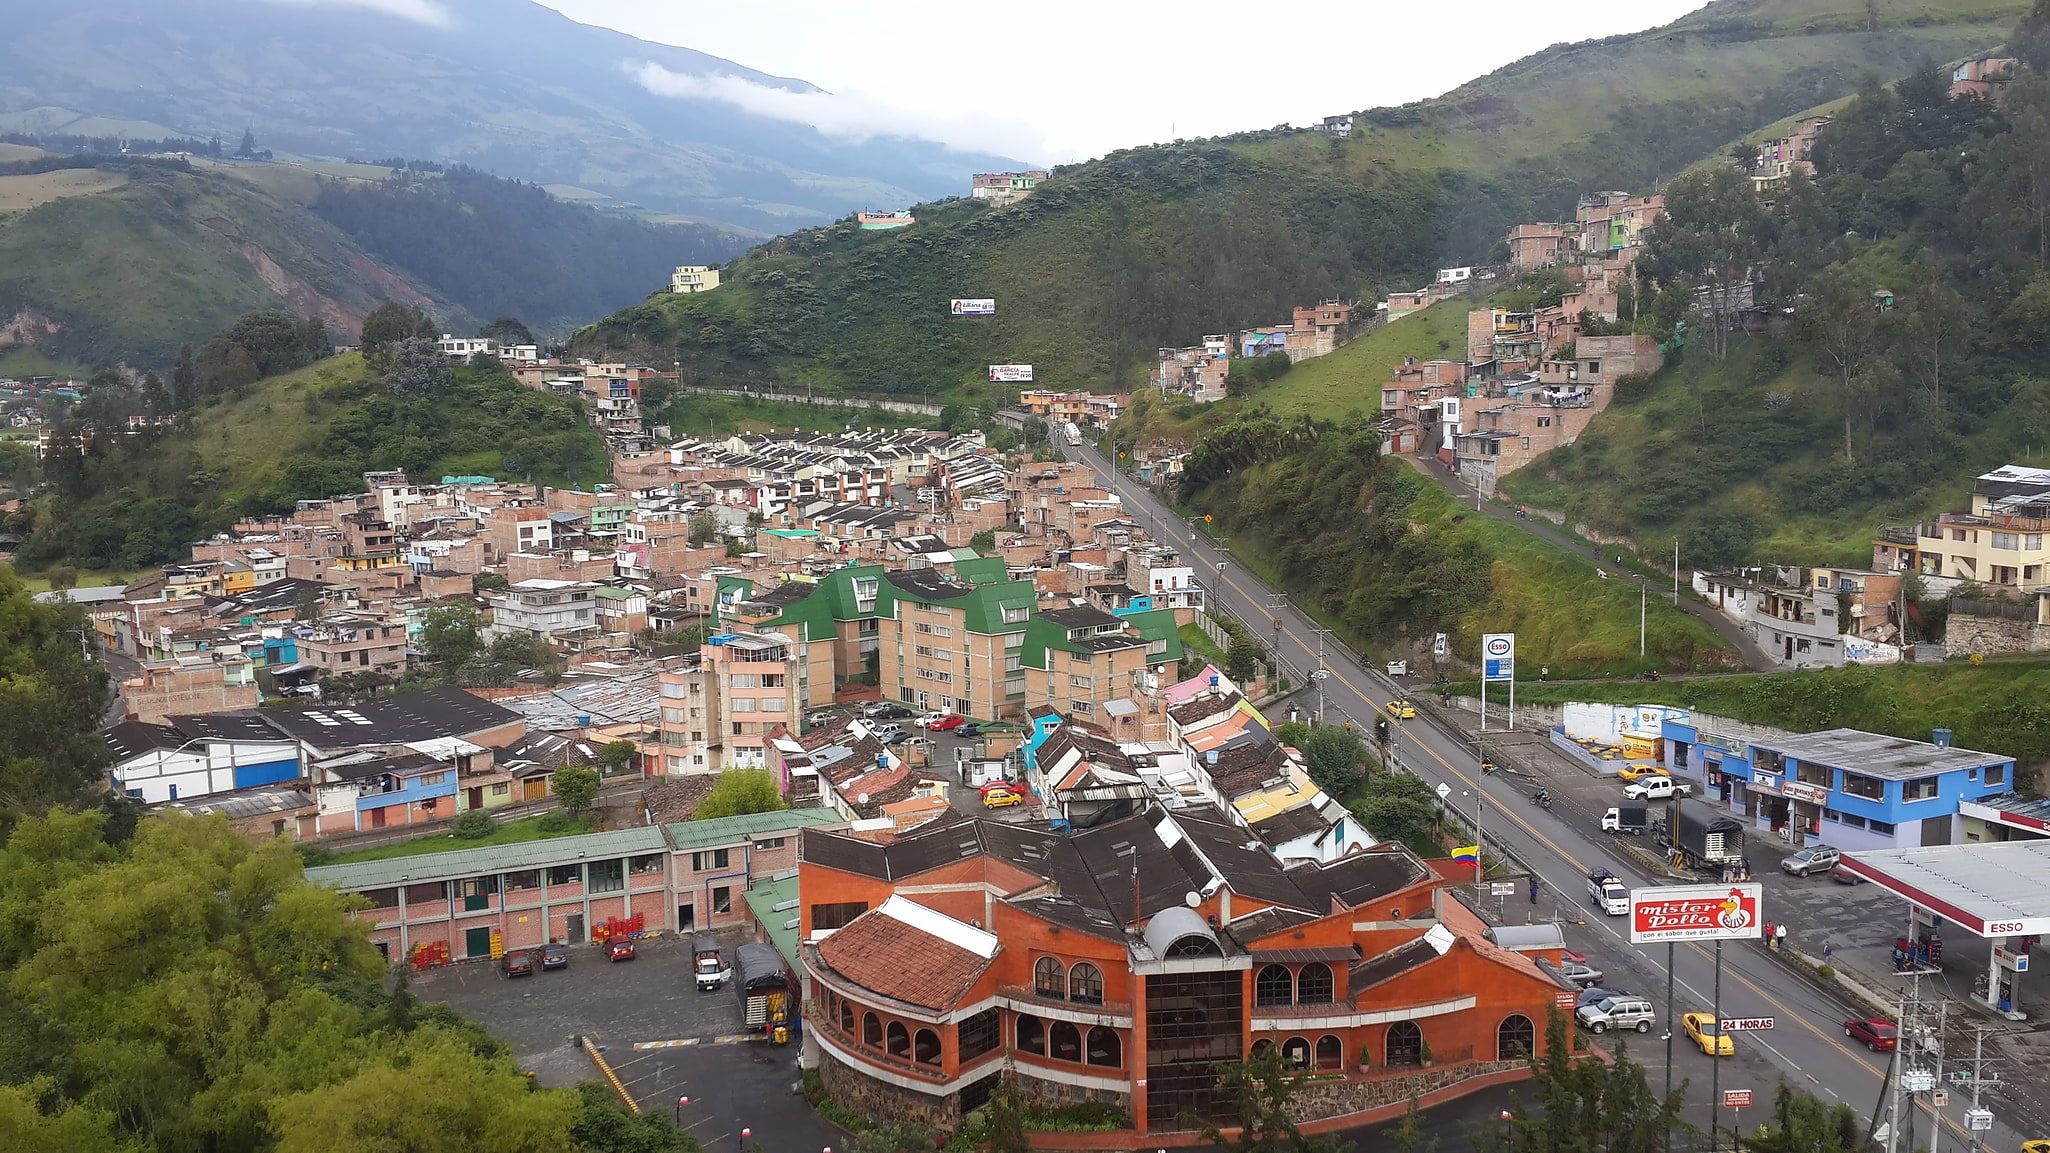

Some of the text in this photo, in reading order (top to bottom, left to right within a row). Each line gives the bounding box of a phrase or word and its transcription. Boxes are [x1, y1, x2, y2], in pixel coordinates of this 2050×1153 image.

[1640, 902, 1717, 916] mister
[1648, 915, 1712, 928] Pollo
[1990, 923, 2023, 933] ESSO
[1722, 1020, 1773, 1030] 24 HORAS
